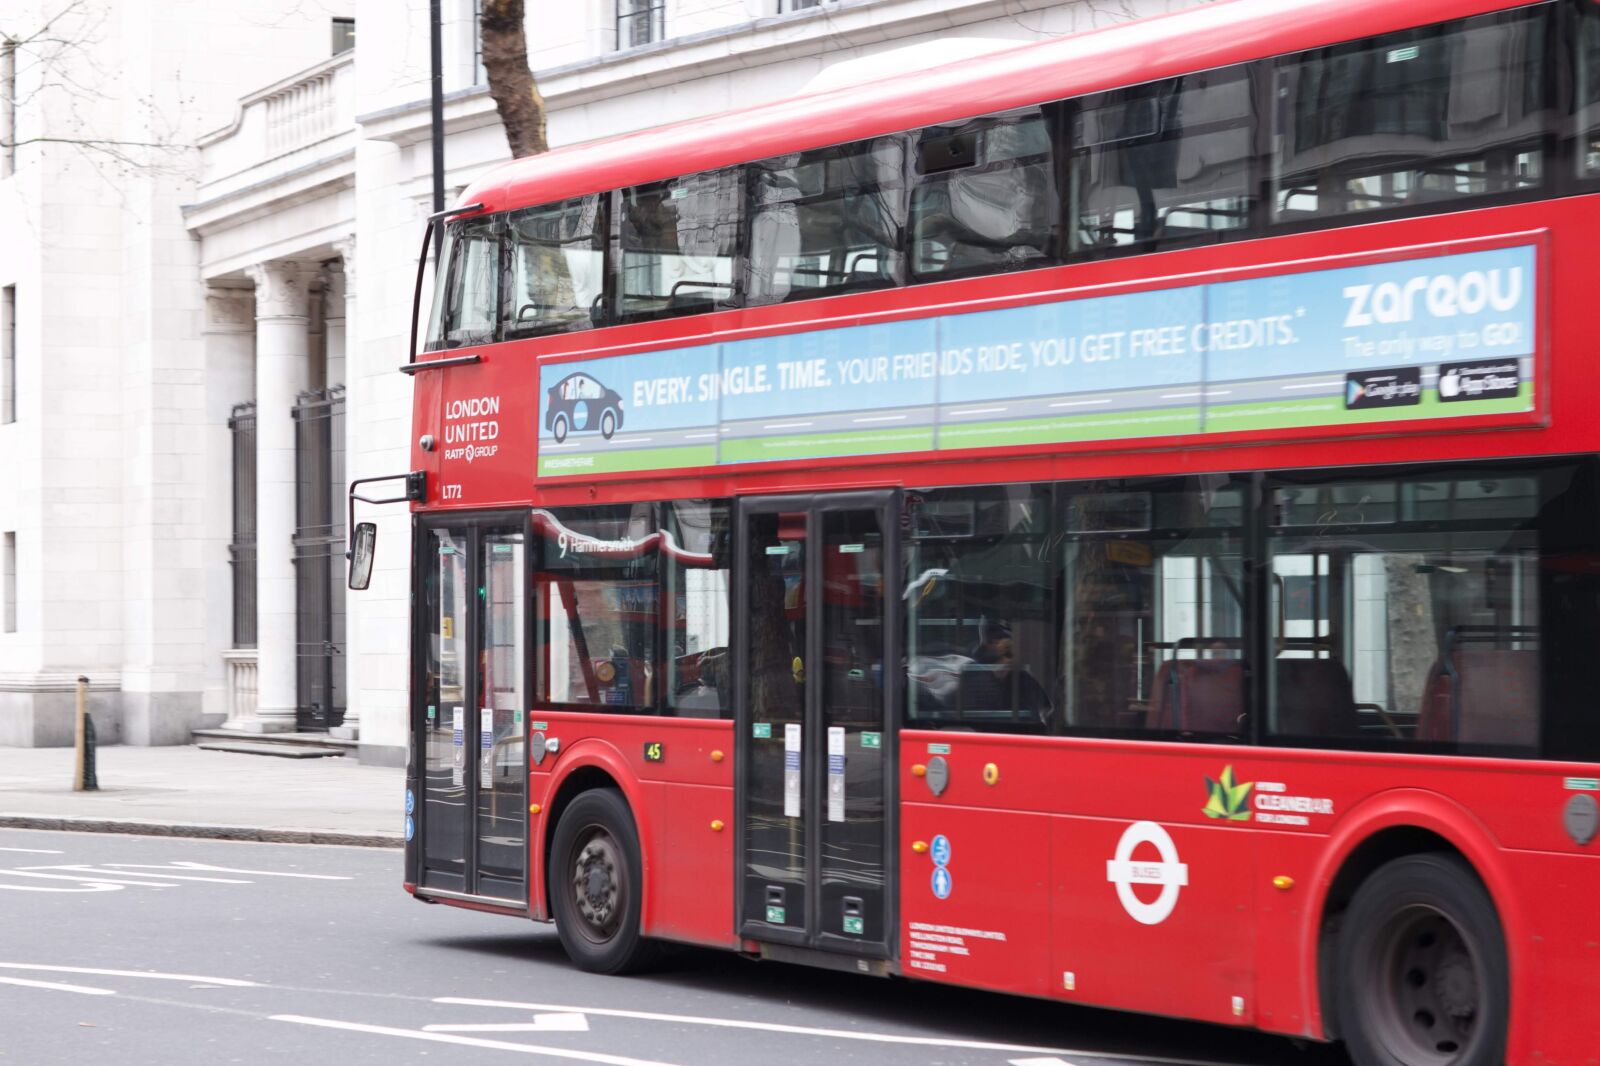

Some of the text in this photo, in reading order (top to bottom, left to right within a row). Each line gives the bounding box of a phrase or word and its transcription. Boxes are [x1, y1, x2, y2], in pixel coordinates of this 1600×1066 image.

[1341, 335, 1376, 358] The
[632, 379, 693, 407] EVERY.
[697, 364, 772, 402] SINGLE.
[777, 358, 832, 391] TIME.
[837, 356, 888, 385] YOUR
[892, 347, 973, 381] FRIENDS
[977, 342, 1027, 374] RIDE,
[1029, 337, 1076, 367] YOU
[1080, 331, 1126, 363] GET
[1129, 325, 1186, 358] FREE
[445, 396, 500, 420] LONDON
[445, 421, 499, 444] UNITED
[445, 445, 498, 460] RATP GROUP
[442, 484, 462, 499] LT72
[558, 531, 568, 559] 9
[647, 743, 661, 760] 45
